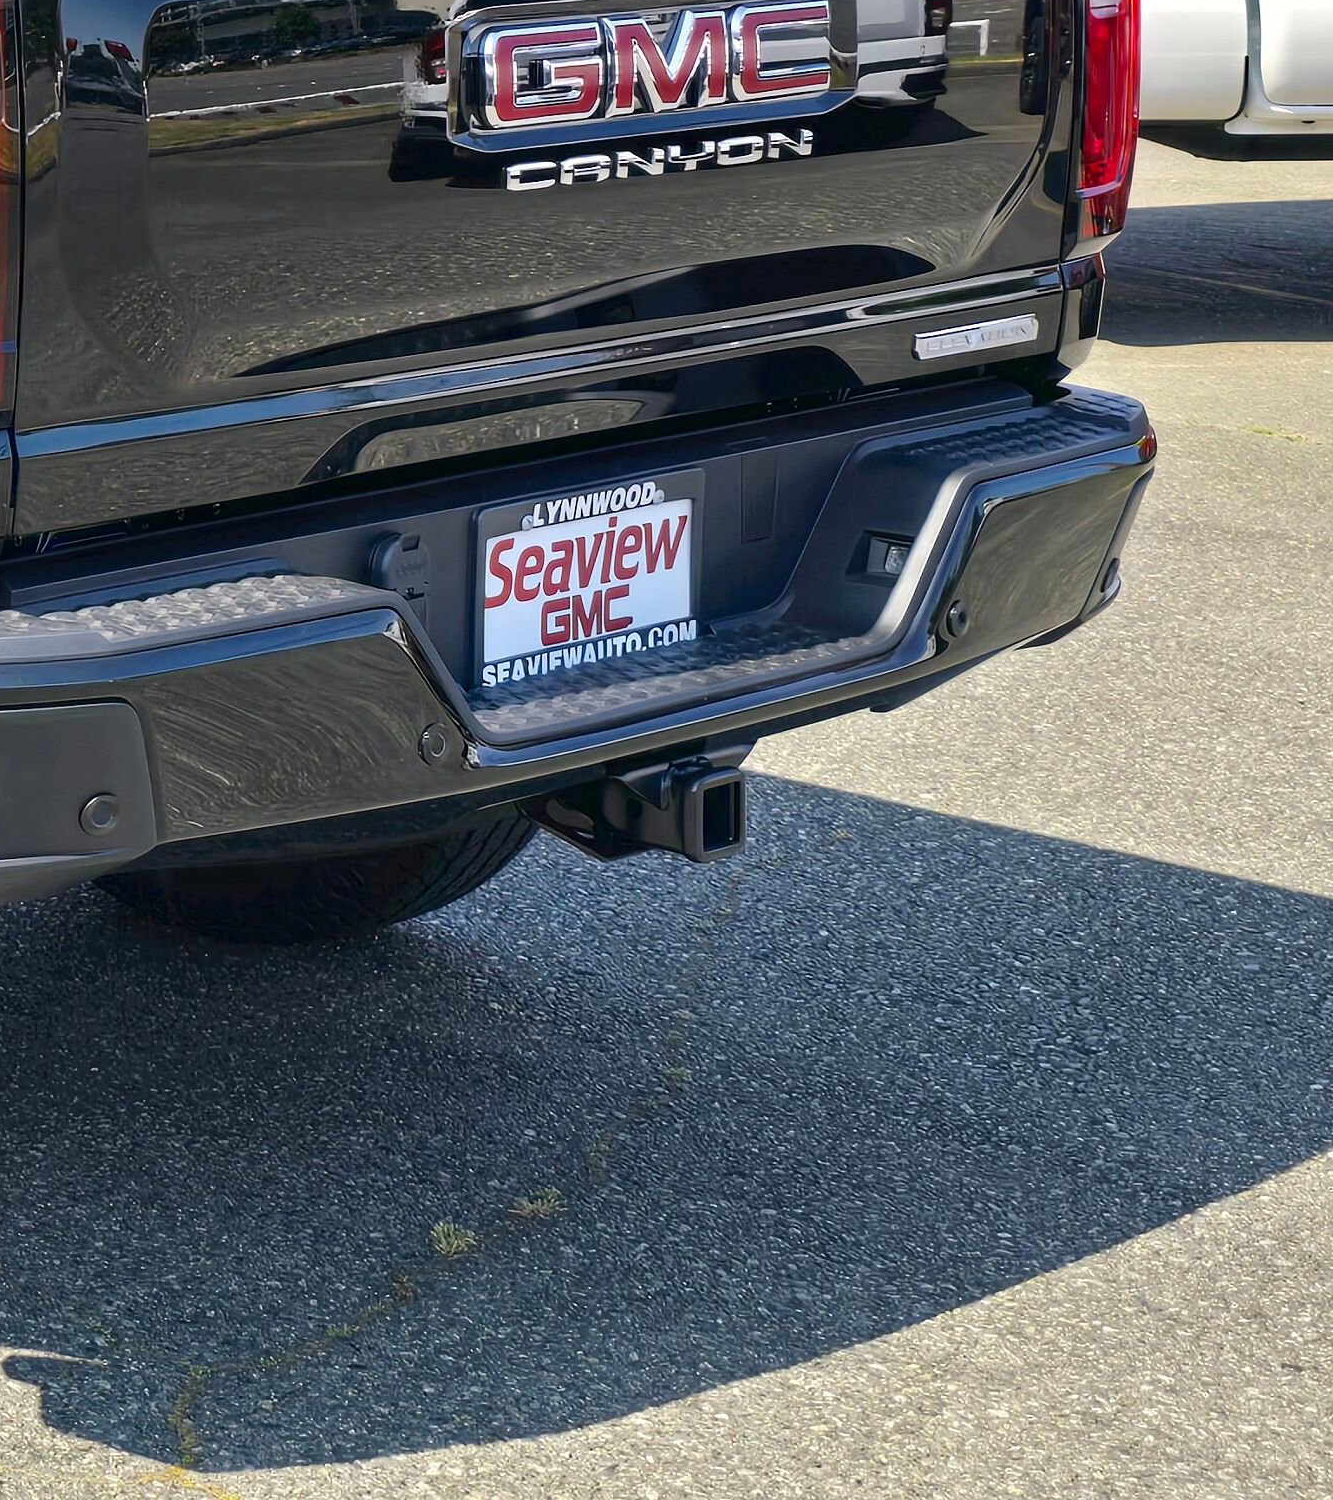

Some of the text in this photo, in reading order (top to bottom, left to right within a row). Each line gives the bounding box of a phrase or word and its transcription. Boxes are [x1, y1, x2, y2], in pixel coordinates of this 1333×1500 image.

[505, 128, 814, 192] CANYON
[532, 481, 656, 528] LYNNWOOD
[484, 515, 688, 609] Seaview
[540, 583, 633, 647] GMC
[482, 619, 697, 687] SEAVIEWAUTO.COM
